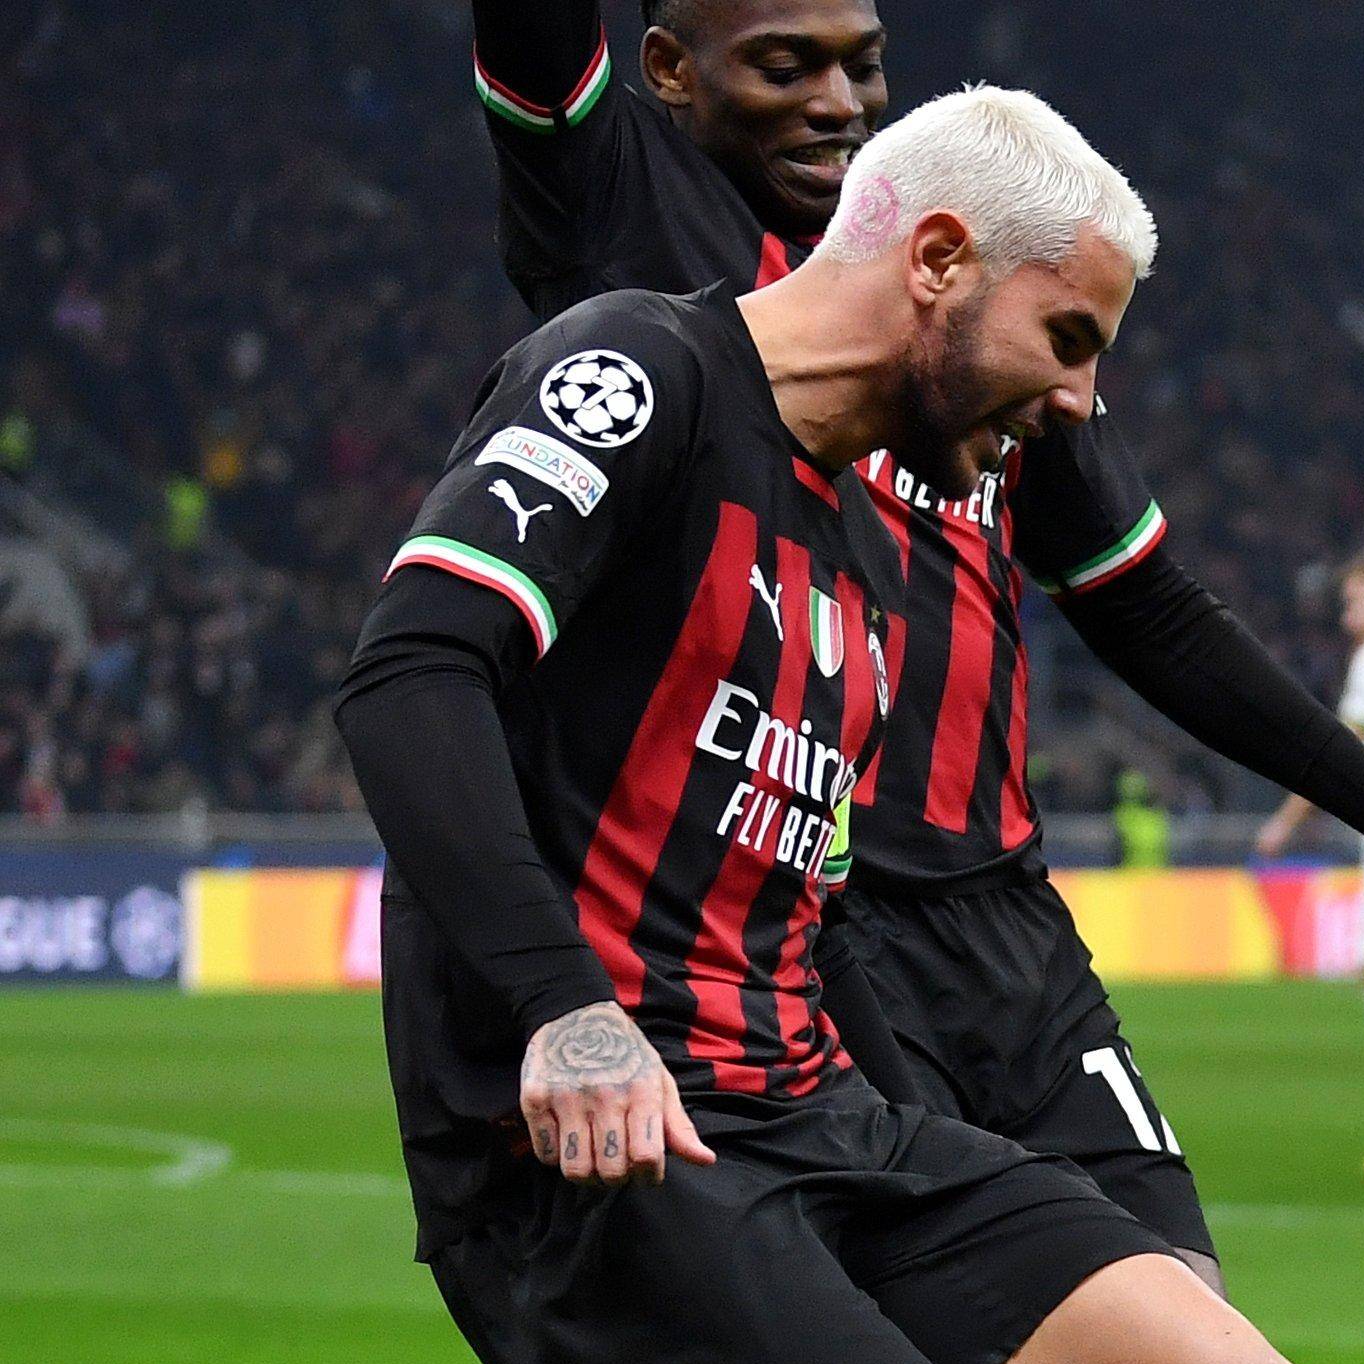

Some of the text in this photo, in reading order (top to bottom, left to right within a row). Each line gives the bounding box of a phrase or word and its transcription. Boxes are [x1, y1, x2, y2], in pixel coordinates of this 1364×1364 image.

[489, 433, 600, 503] UNDATION
[716, 781, 837, 879] FLY BETT
